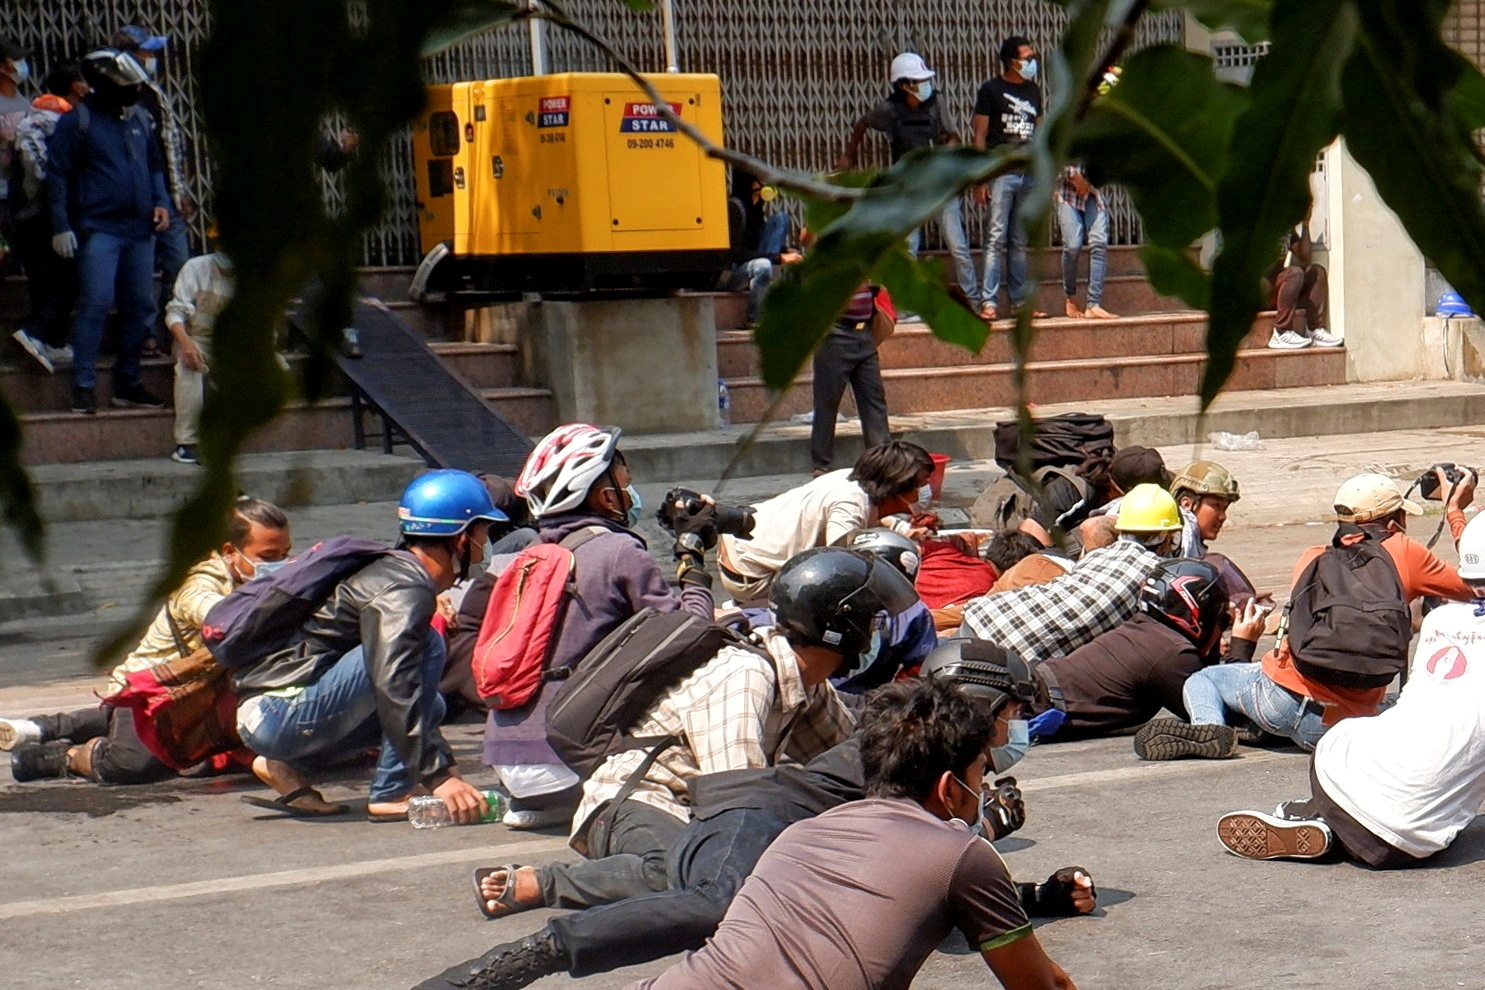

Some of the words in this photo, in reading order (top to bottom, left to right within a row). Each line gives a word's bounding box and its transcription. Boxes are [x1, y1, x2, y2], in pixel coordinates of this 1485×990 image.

[632, 104, 675, 116] POWR
[543, 113, 564, 126] STAR
[632, 120, 668, 131] STAR
[627, 138, 653, 149] 09-200
